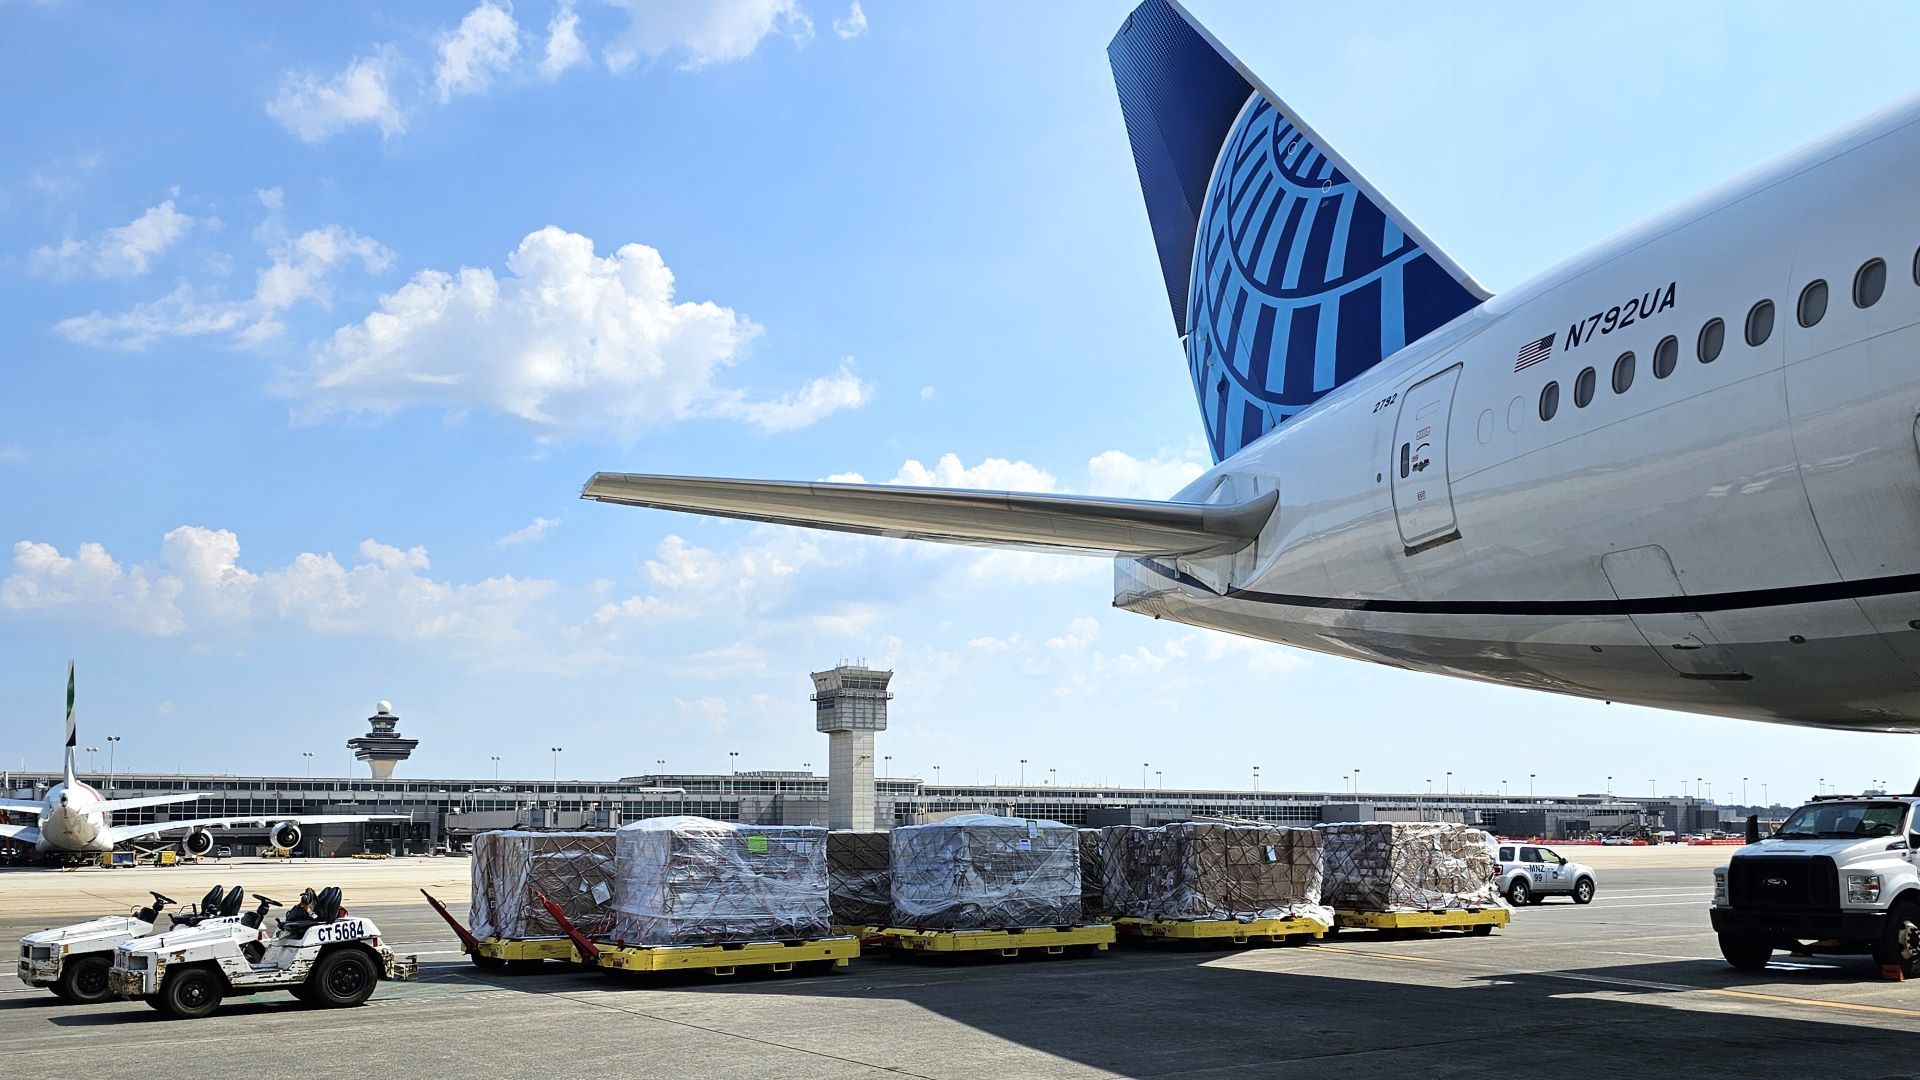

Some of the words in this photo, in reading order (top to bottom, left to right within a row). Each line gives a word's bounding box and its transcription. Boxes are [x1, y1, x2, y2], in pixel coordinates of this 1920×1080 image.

[1564, 281, 1676, 352] N792UA
[1372, 393, 1398, 414] 2792
[1529, 864, 1546, 873] MNZ
[1533, 873, 1543, 882] 99
[318, 927, 332, 942] CT
[334, 920, 364, 941] 5684
